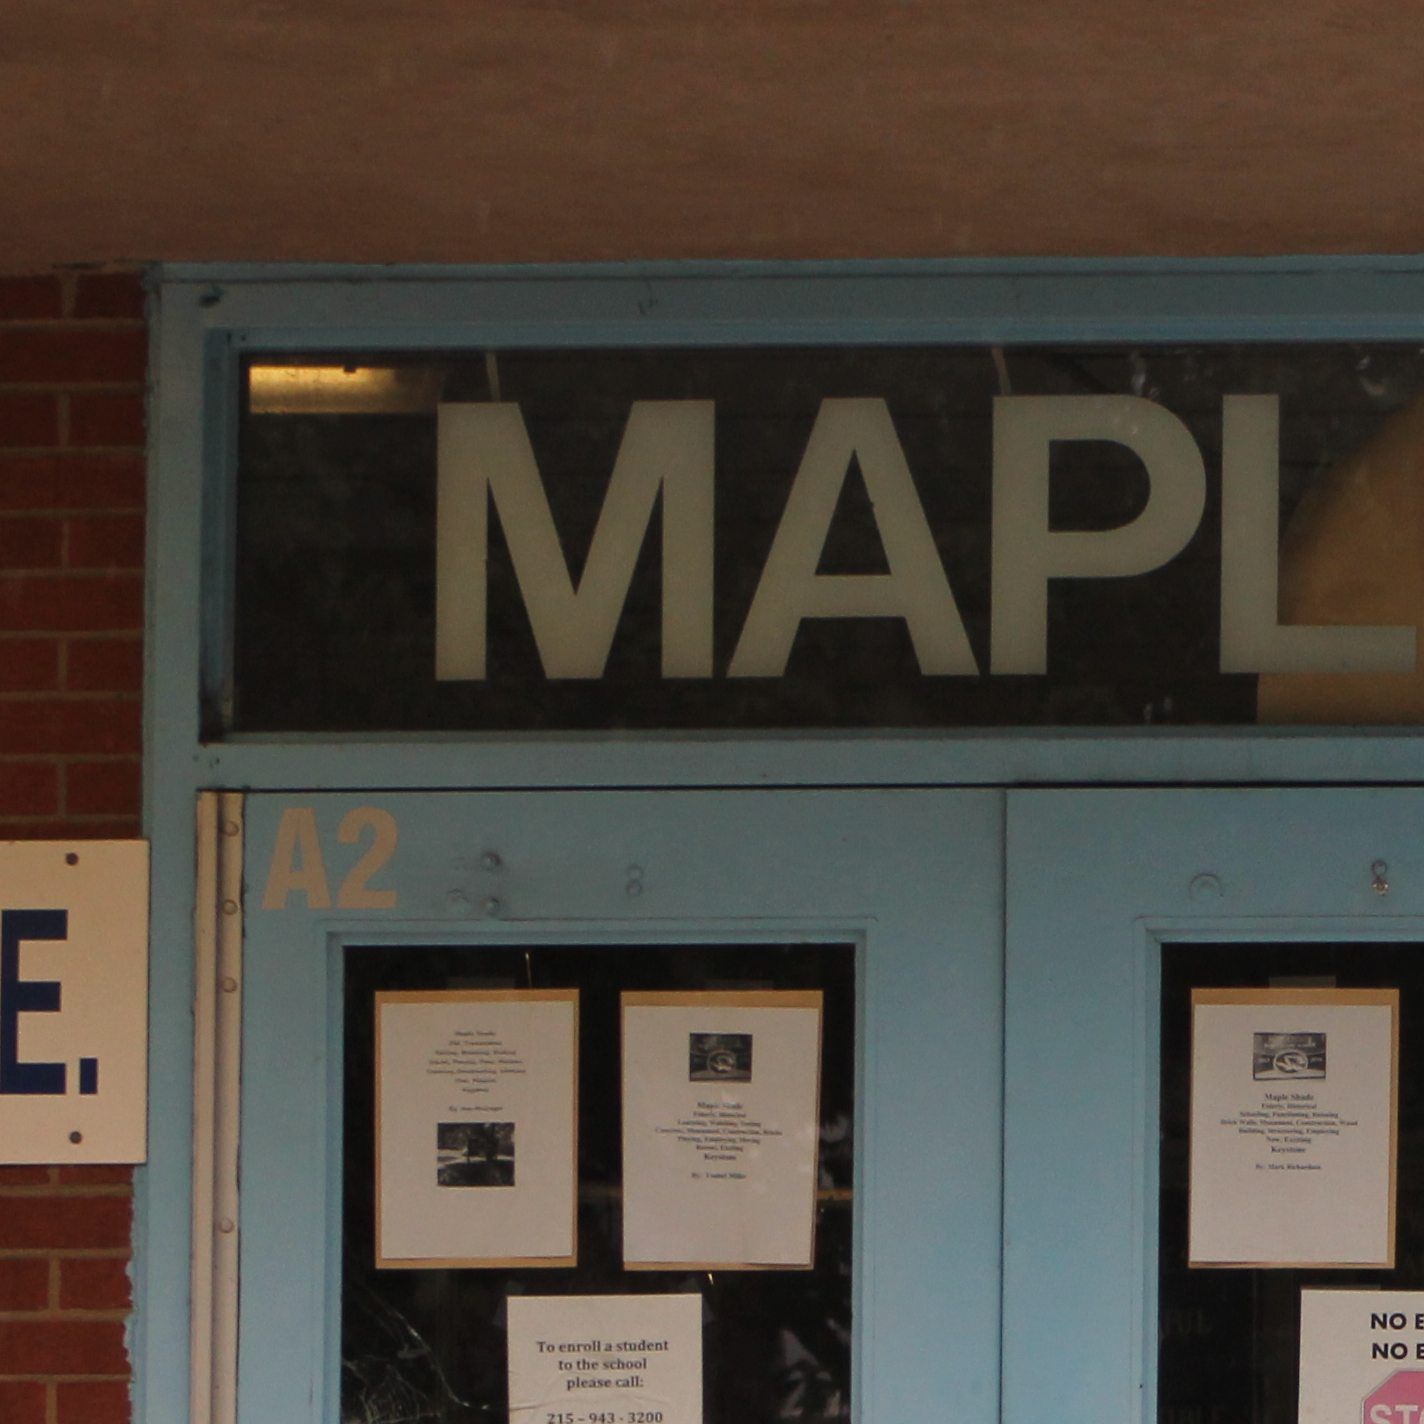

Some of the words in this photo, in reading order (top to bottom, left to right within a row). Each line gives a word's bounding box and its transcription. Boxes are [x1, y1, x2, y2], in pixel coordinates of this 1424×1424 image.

[261, 806, 398, 911] A2
[1370, 1313, 1407, 1330] NO
[536, 1341, 555, 1353] To
[559, 1340, 600, 1352] enroll
[605, 1343, 612, 1352] a
[616, 1340, 669, 1352] student
[1372, 1343, 1408, 1360] NO
[558, 1359, 572, 1370] to
[576, 1358, 598, 1370] the
[602, 1357, 647, 1370] school
[567, 1376, 612, 1391] please
[615, 1375, 644, 1388] call:
[546, 1412, 573, 1424] 215
[589, 1412, 615, 1424] 943
[627, 1411, 663, 1424] 3200
